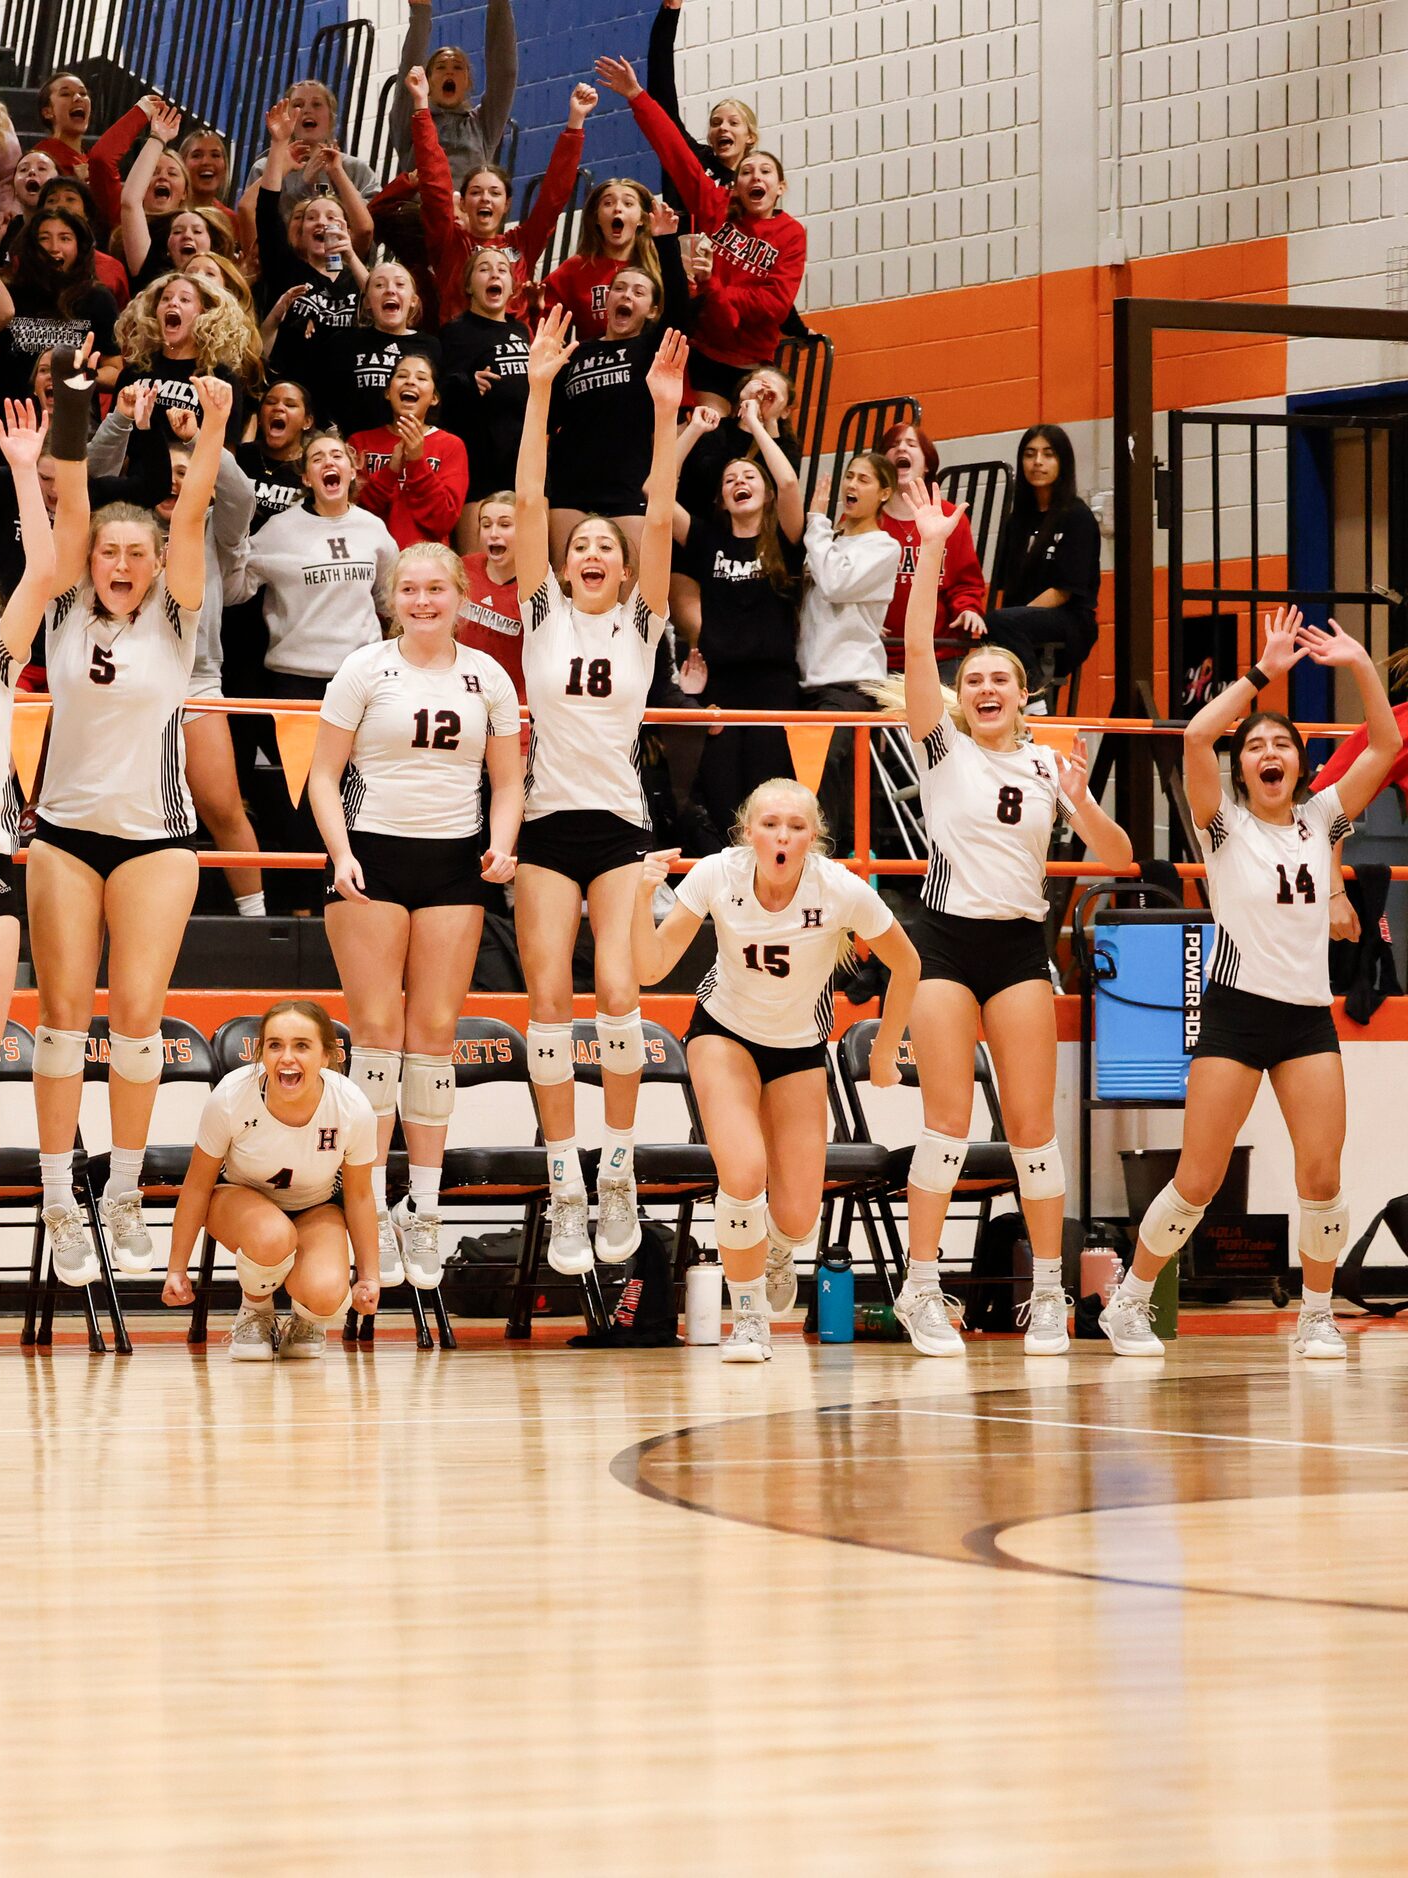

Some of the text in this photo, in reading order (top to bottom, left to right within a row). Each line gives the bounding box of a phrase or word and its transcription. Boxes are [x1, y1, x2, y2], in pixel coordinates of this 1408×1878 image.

[711, 222, 779, 271] HEATH
[154, 398, 201, 416] OLLEYBALL
[326, 537, 351, 560] H
[304, 569, 342, 586] HEATH
[89, 643, 116, 685] 5
[565, 656, 613, 698] 18
[461, 674, 484, 694] H
[410, 708, 461, 751] 12
[996, 785, 1024, 826] 8
[1276, 863, 1316, 905] 14
[801, 908, 824, 928] H
[742, 943, 790, 979] 15
[1184, 932, 1202, 1049] POWERADE
[317, 1127, 339, 1152] H
[266, 1167, 294, 1190] 4
